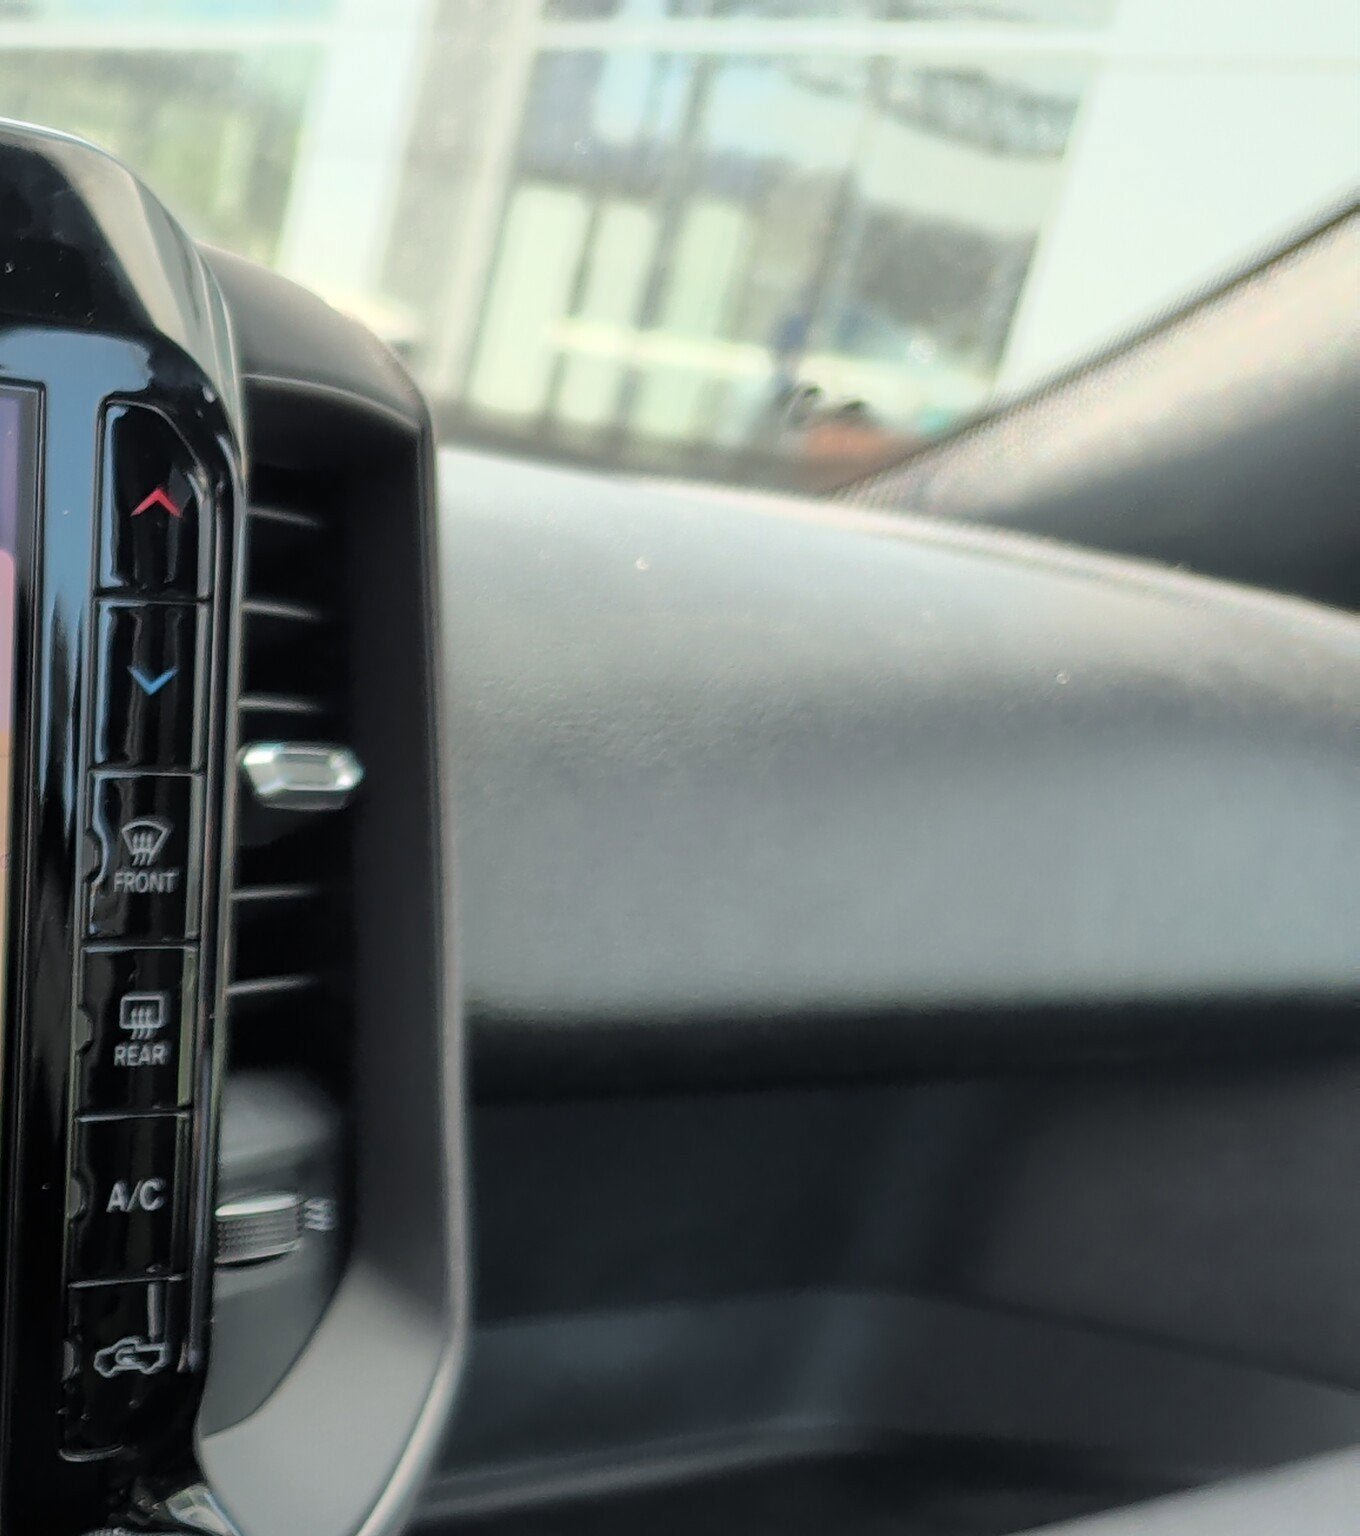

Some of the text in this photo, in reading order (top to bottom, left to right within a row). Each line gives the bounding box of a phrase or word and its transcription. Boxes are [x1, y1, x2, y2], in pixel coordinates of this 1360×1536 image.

[112, 871, 178, 894] FRONT
[113, 1044, 169, 1067] REAR
[106, 1180, 166, 1213] A/C
